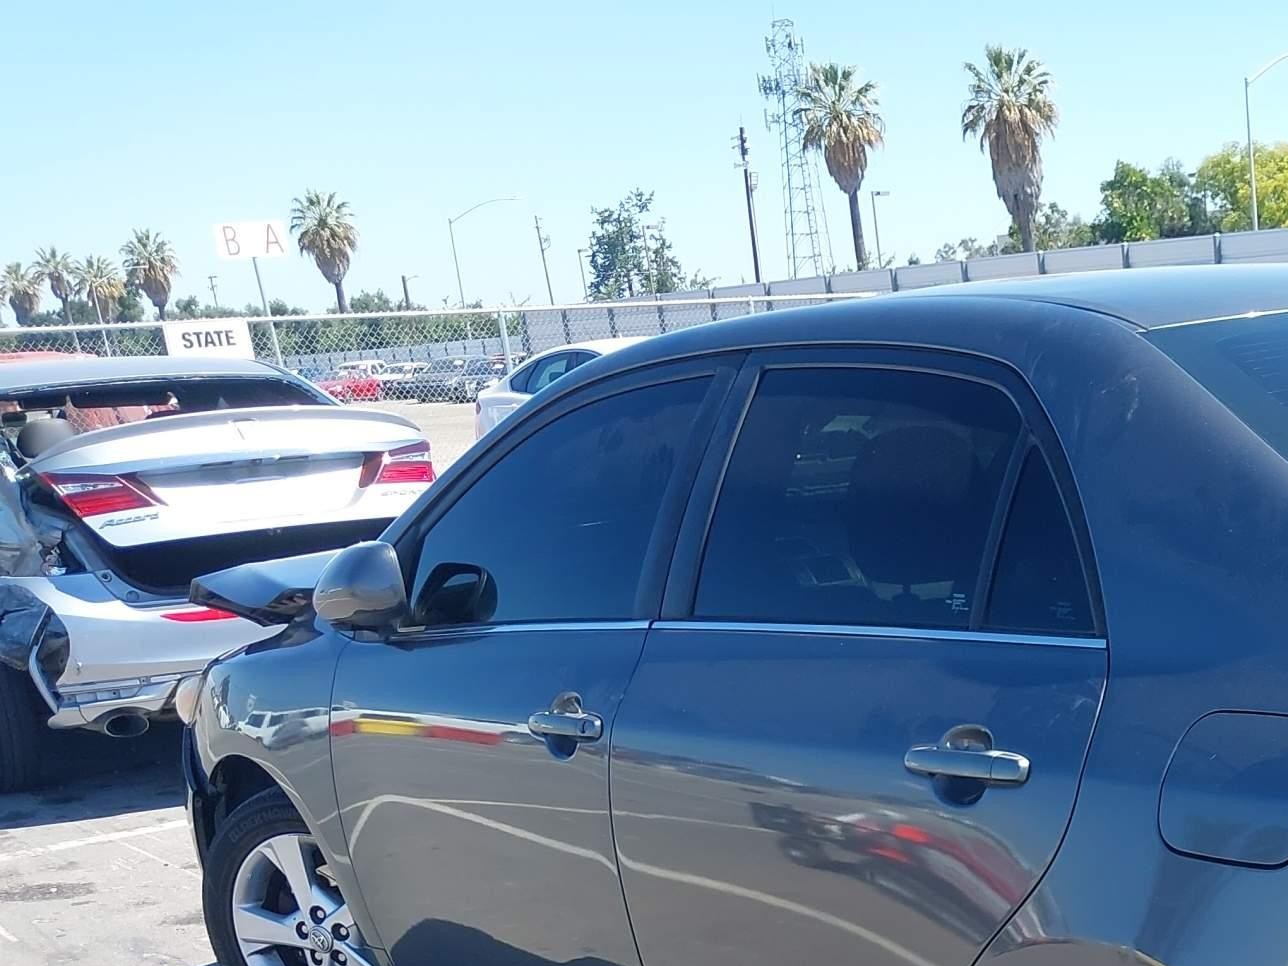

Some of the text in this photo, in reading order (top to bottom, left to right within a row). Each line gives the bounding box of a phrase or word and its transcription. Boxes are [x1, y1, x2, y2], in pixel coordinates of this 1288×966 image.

[222, 223, 285, 257] B A
[181, 329, 237, 349] STATE
